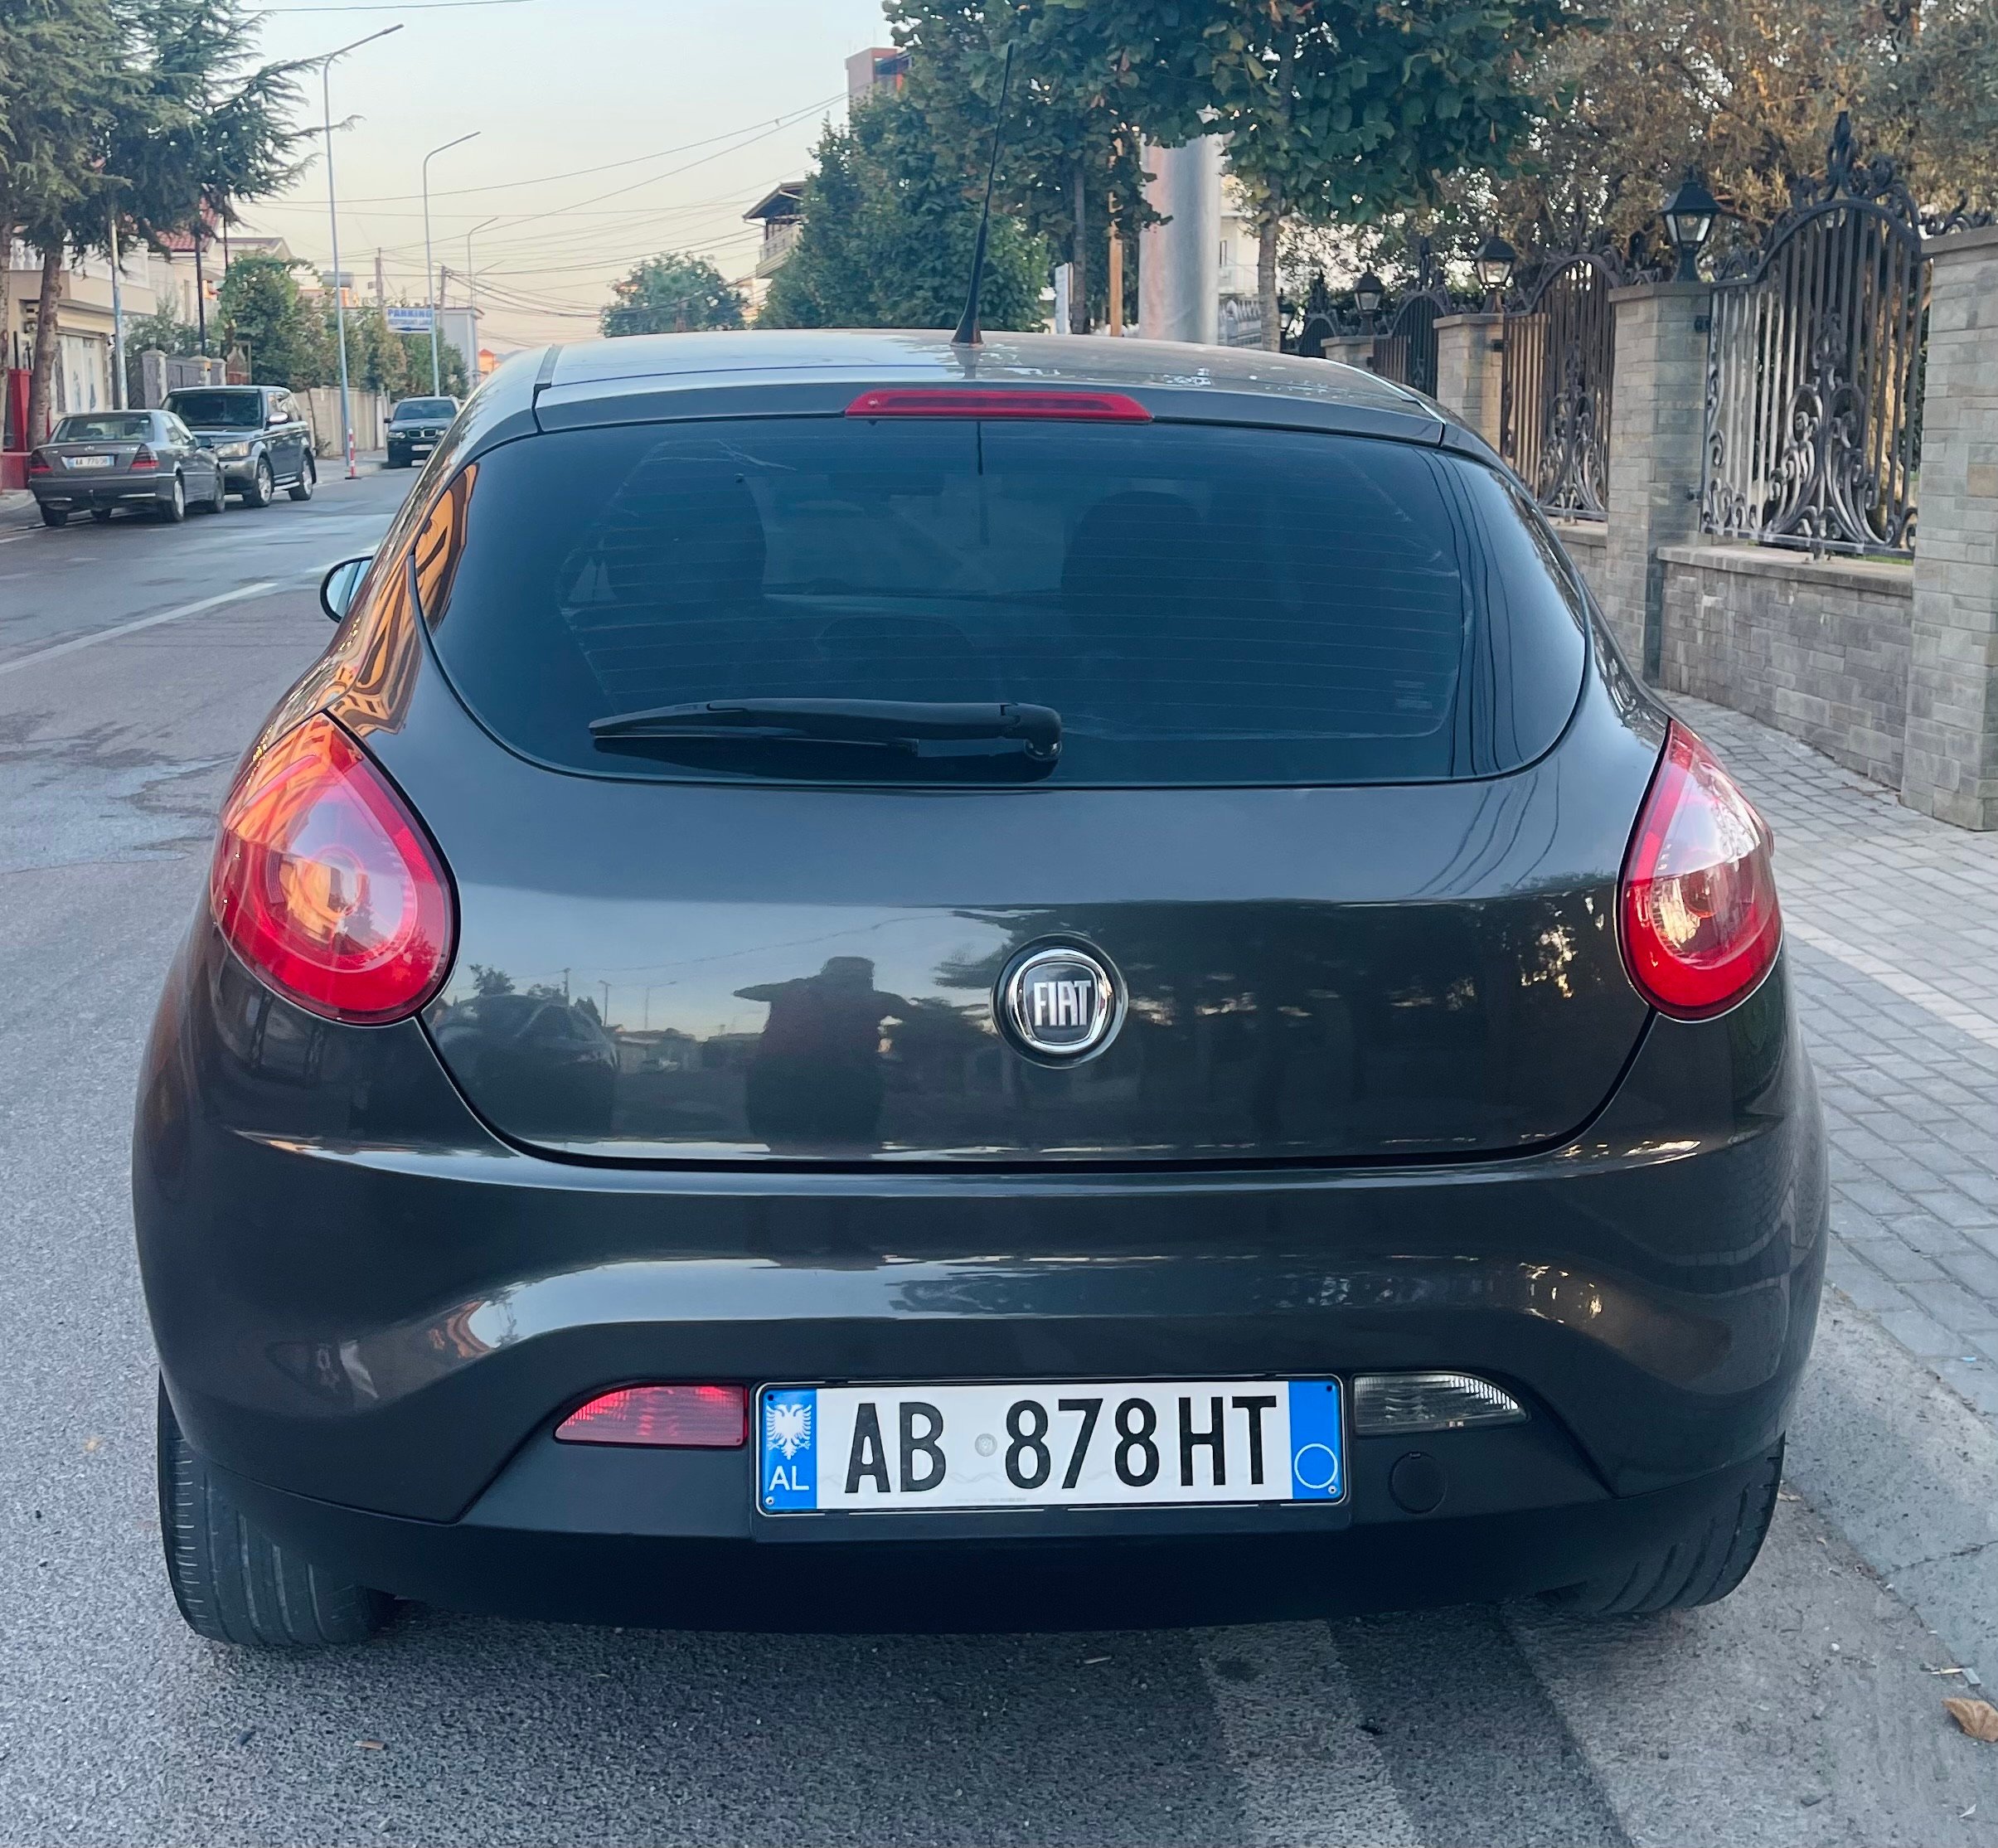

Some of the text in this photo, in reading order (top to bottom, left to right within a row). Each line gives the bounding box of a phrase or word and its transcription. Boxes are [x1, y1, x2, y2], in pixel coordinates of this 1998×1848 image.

[387, 309, 432, 318] PARKING
[1033, 982, 1092, 1026] FIAT
[845, 1396, 1277, 1493] AB 878HT
[769, 1465, 810, 1491] AL
